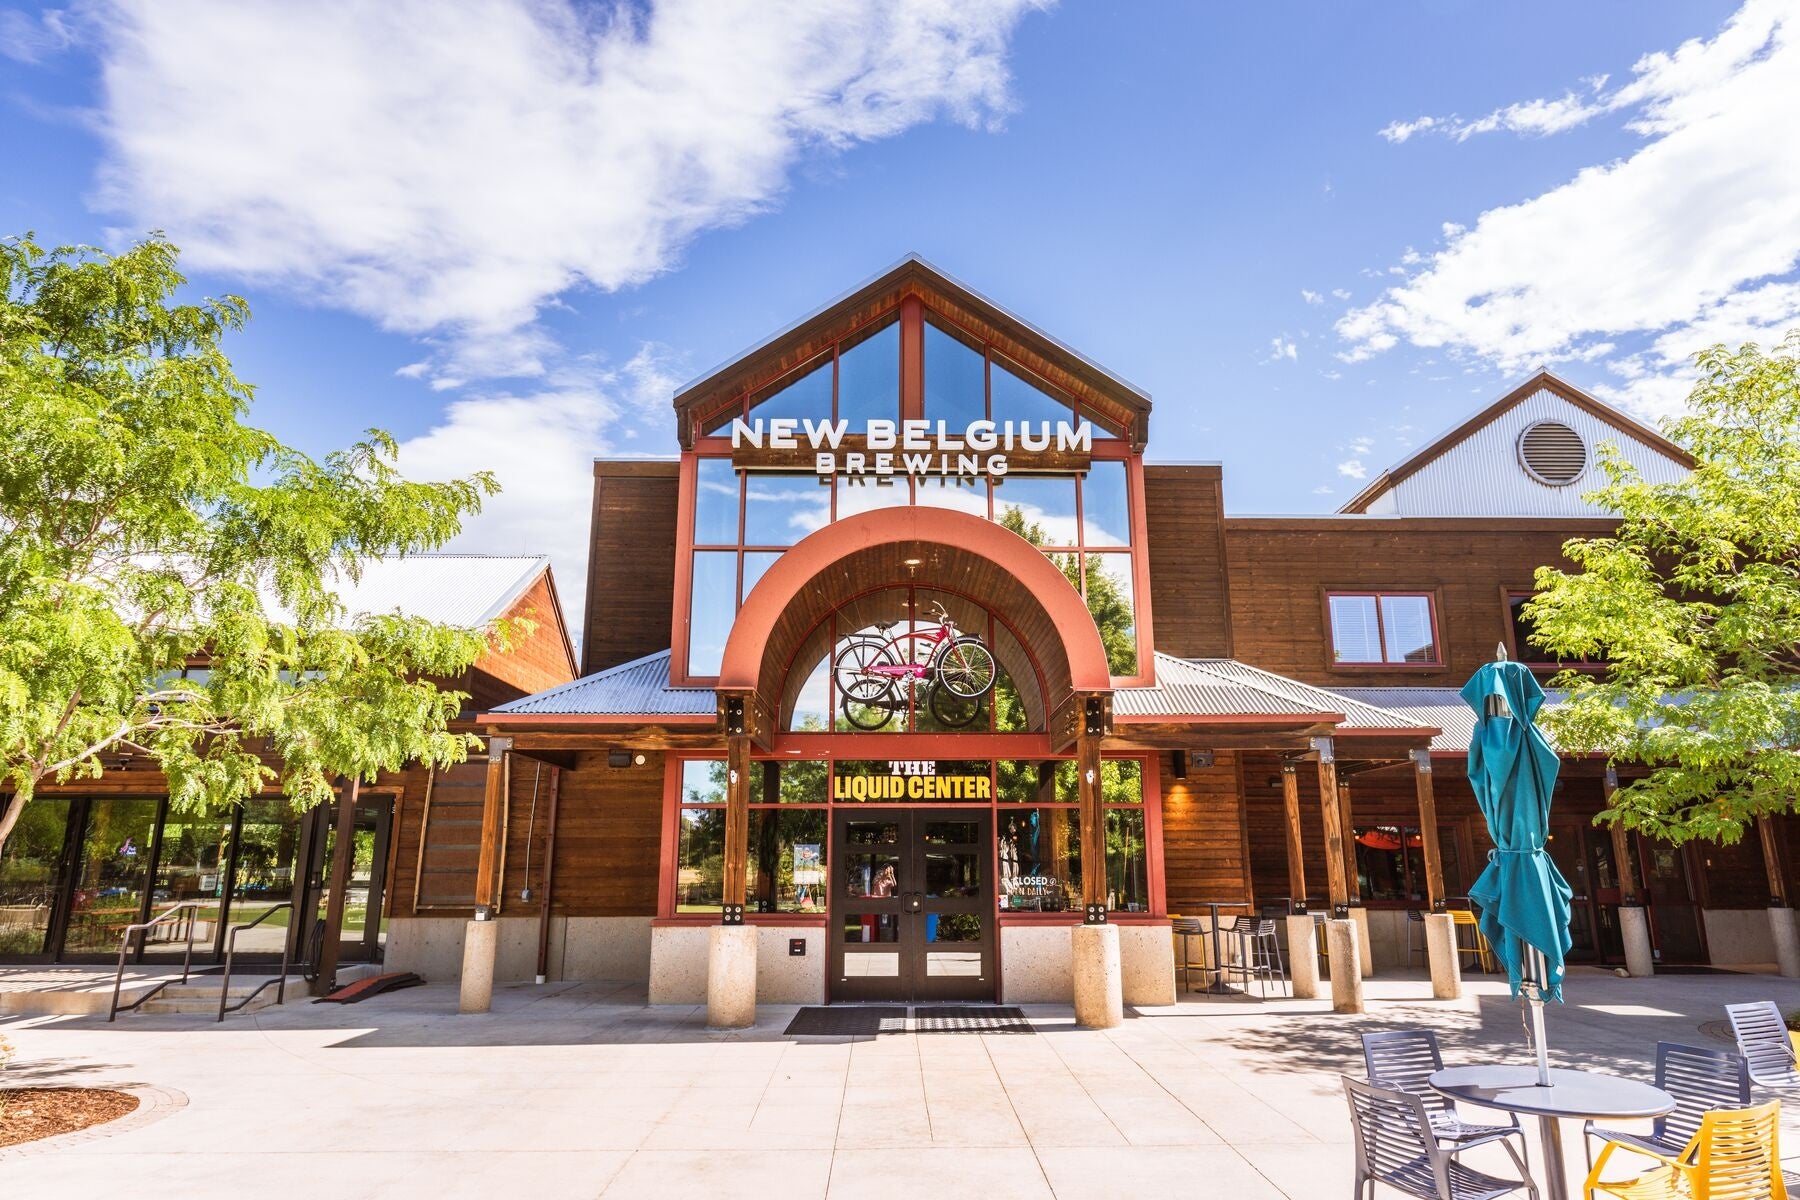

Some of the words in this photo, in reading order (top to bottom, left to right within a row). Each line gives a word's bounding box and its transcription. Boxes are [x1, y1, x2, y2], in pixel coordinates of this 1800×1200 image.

[731, 418, 849, 449] NEW
[866, 419, 1092, 452] BELGIUM
[816, 452, 1009, 476] BREWING
[888, 760, 936, 776] THE
[834, 775, 905, 803] LIQUID
[907, 775, 991, 799] CENTER
